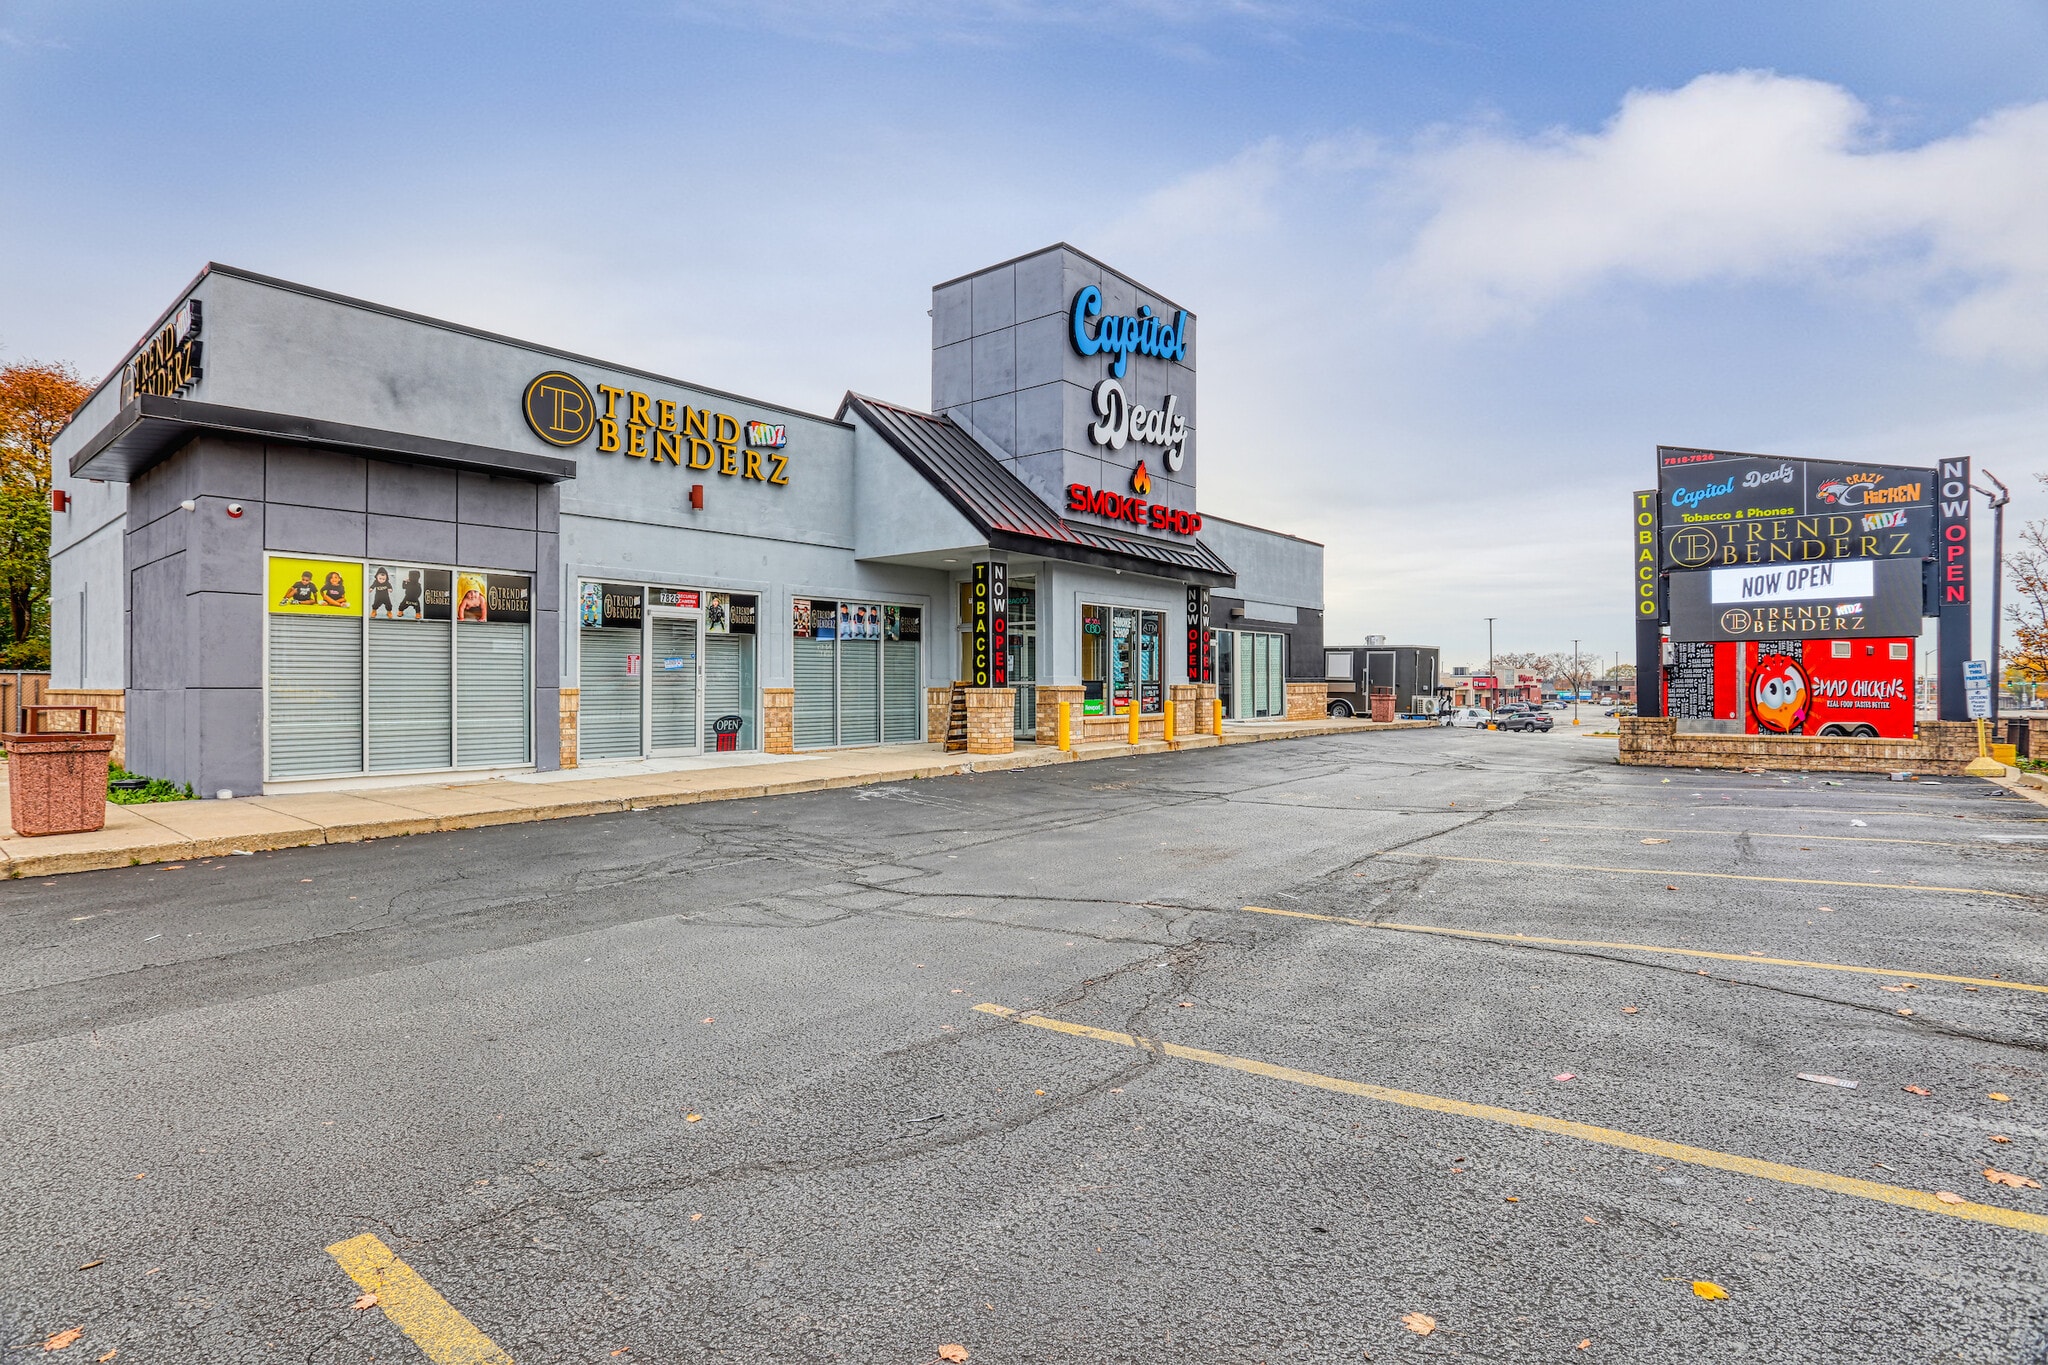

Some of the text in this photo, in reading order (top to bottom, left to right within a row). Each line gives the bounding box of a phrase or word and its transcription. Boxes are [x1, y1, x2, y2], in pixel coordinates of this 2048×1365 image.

[1071, 285, 1188, 379] Capitol
[135, 322, 175, 389] TREND
[598, 383, 787, 448] TREND KIDZ
[1088, 379, 1188, 473] Dealz
[597, 418, 789, 485] BENDERZ
[1664, 453, 1715, 466] 7818-7826
[1671, 463, 1794, 509] Capitol Dealz
[1846, 472, 1884, 485] CRAZY
[1068, 482, 1202, 536] SMOKE SHOP
[1682, 506, 1795, 523] Tobacco & Phones
[1721, 509, 1908, 543] TREND KIDZ
[1941, 462, 1968, 602] NOW OPEN
[1638, 494, 1656, 614] TOBACCO
[1722, 533, 1912, 565] BENDERZ
[498, 587, 521, 599] TREND
[661, 593, 680, 603] 7826
[1742, 564, 1833, 599] NOW OPEN
[497, 600, 529, 612] BENDERZ
[612, 607, 642, 620] BENDERZ
[613, 595, 634, 607] TREND
[1753, 606, 1833, 619] TREND
[975, 565, 987, 686] TOBACCO
[993, 565, 1006, 683] NOW OPEN
[1187, 589, 1199, 679] NOW OPEN
[1753, 616, 1865, 633] BENDERZ
[1820, 678, 1897, 699] MAD CHICKEN
[1872, 701, 1890, 709] BETTER
[716, 720, 739, 730] OPEN
